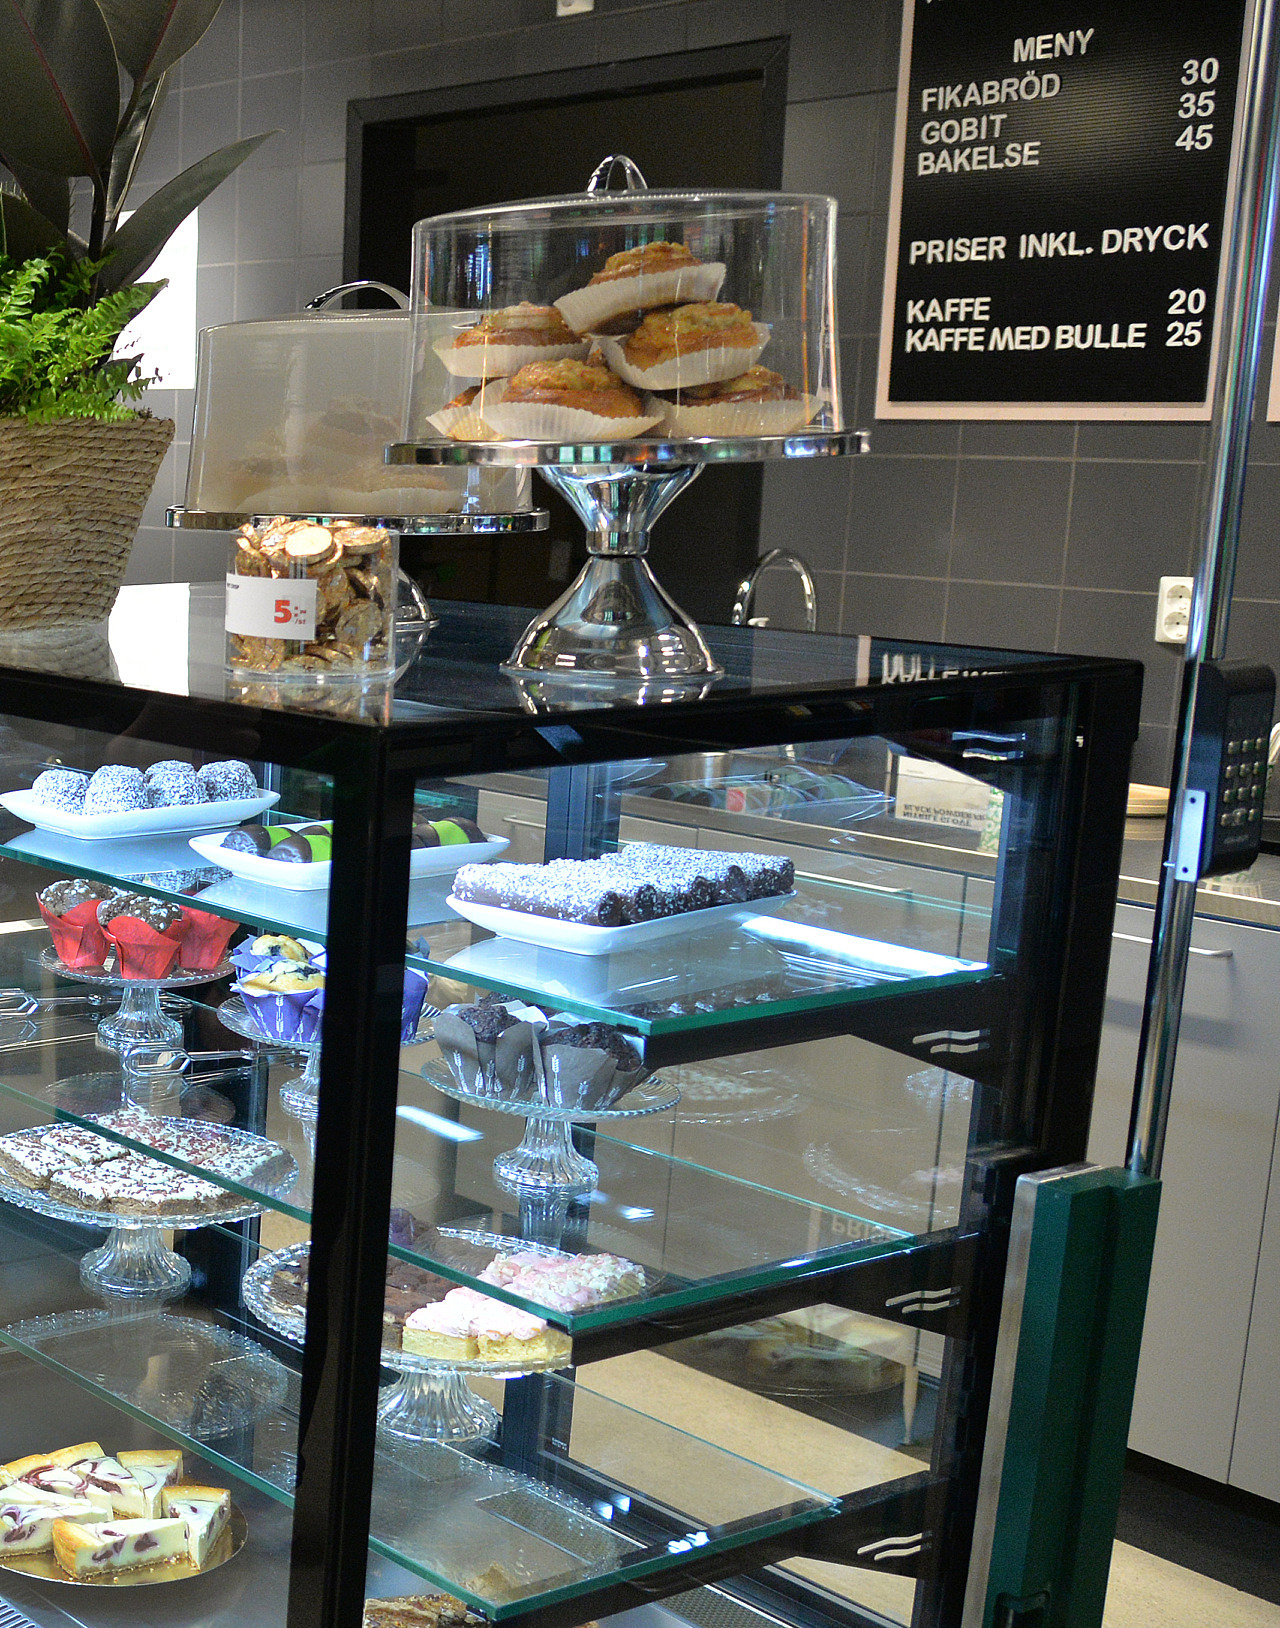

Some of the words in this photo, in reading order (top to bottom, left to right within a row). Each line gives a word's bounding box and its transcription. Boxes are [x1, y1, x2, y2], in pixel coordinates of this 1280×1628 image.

[1013, 28, 1094, 63] MENY
[922, 70, 1061, 112] FIKABRÖD
[1180, 57, 1220, 86] 30
[920, 113, 1008, 145] GOBIT
[1177, 89, 1216, 119] 35
[917, 141, 1042, 176] BAKELSE
[1174, 123, 1214, 151] 45
[909, 235, 1007, 265] PRISER
[1019, 231, 1095, 259] INKL.
[1101, 222, 1210, 255] DRYCK
[906, 296, 992, 324] KAFFE
[1167, 288, 1207, 315] 20
[905, 327, 986, 353] KAFFE
[988, 325, 1051, 351] MED
[1054, 322, 1148, 350] BULLE
[1164, 319, 1203, 347] 25
